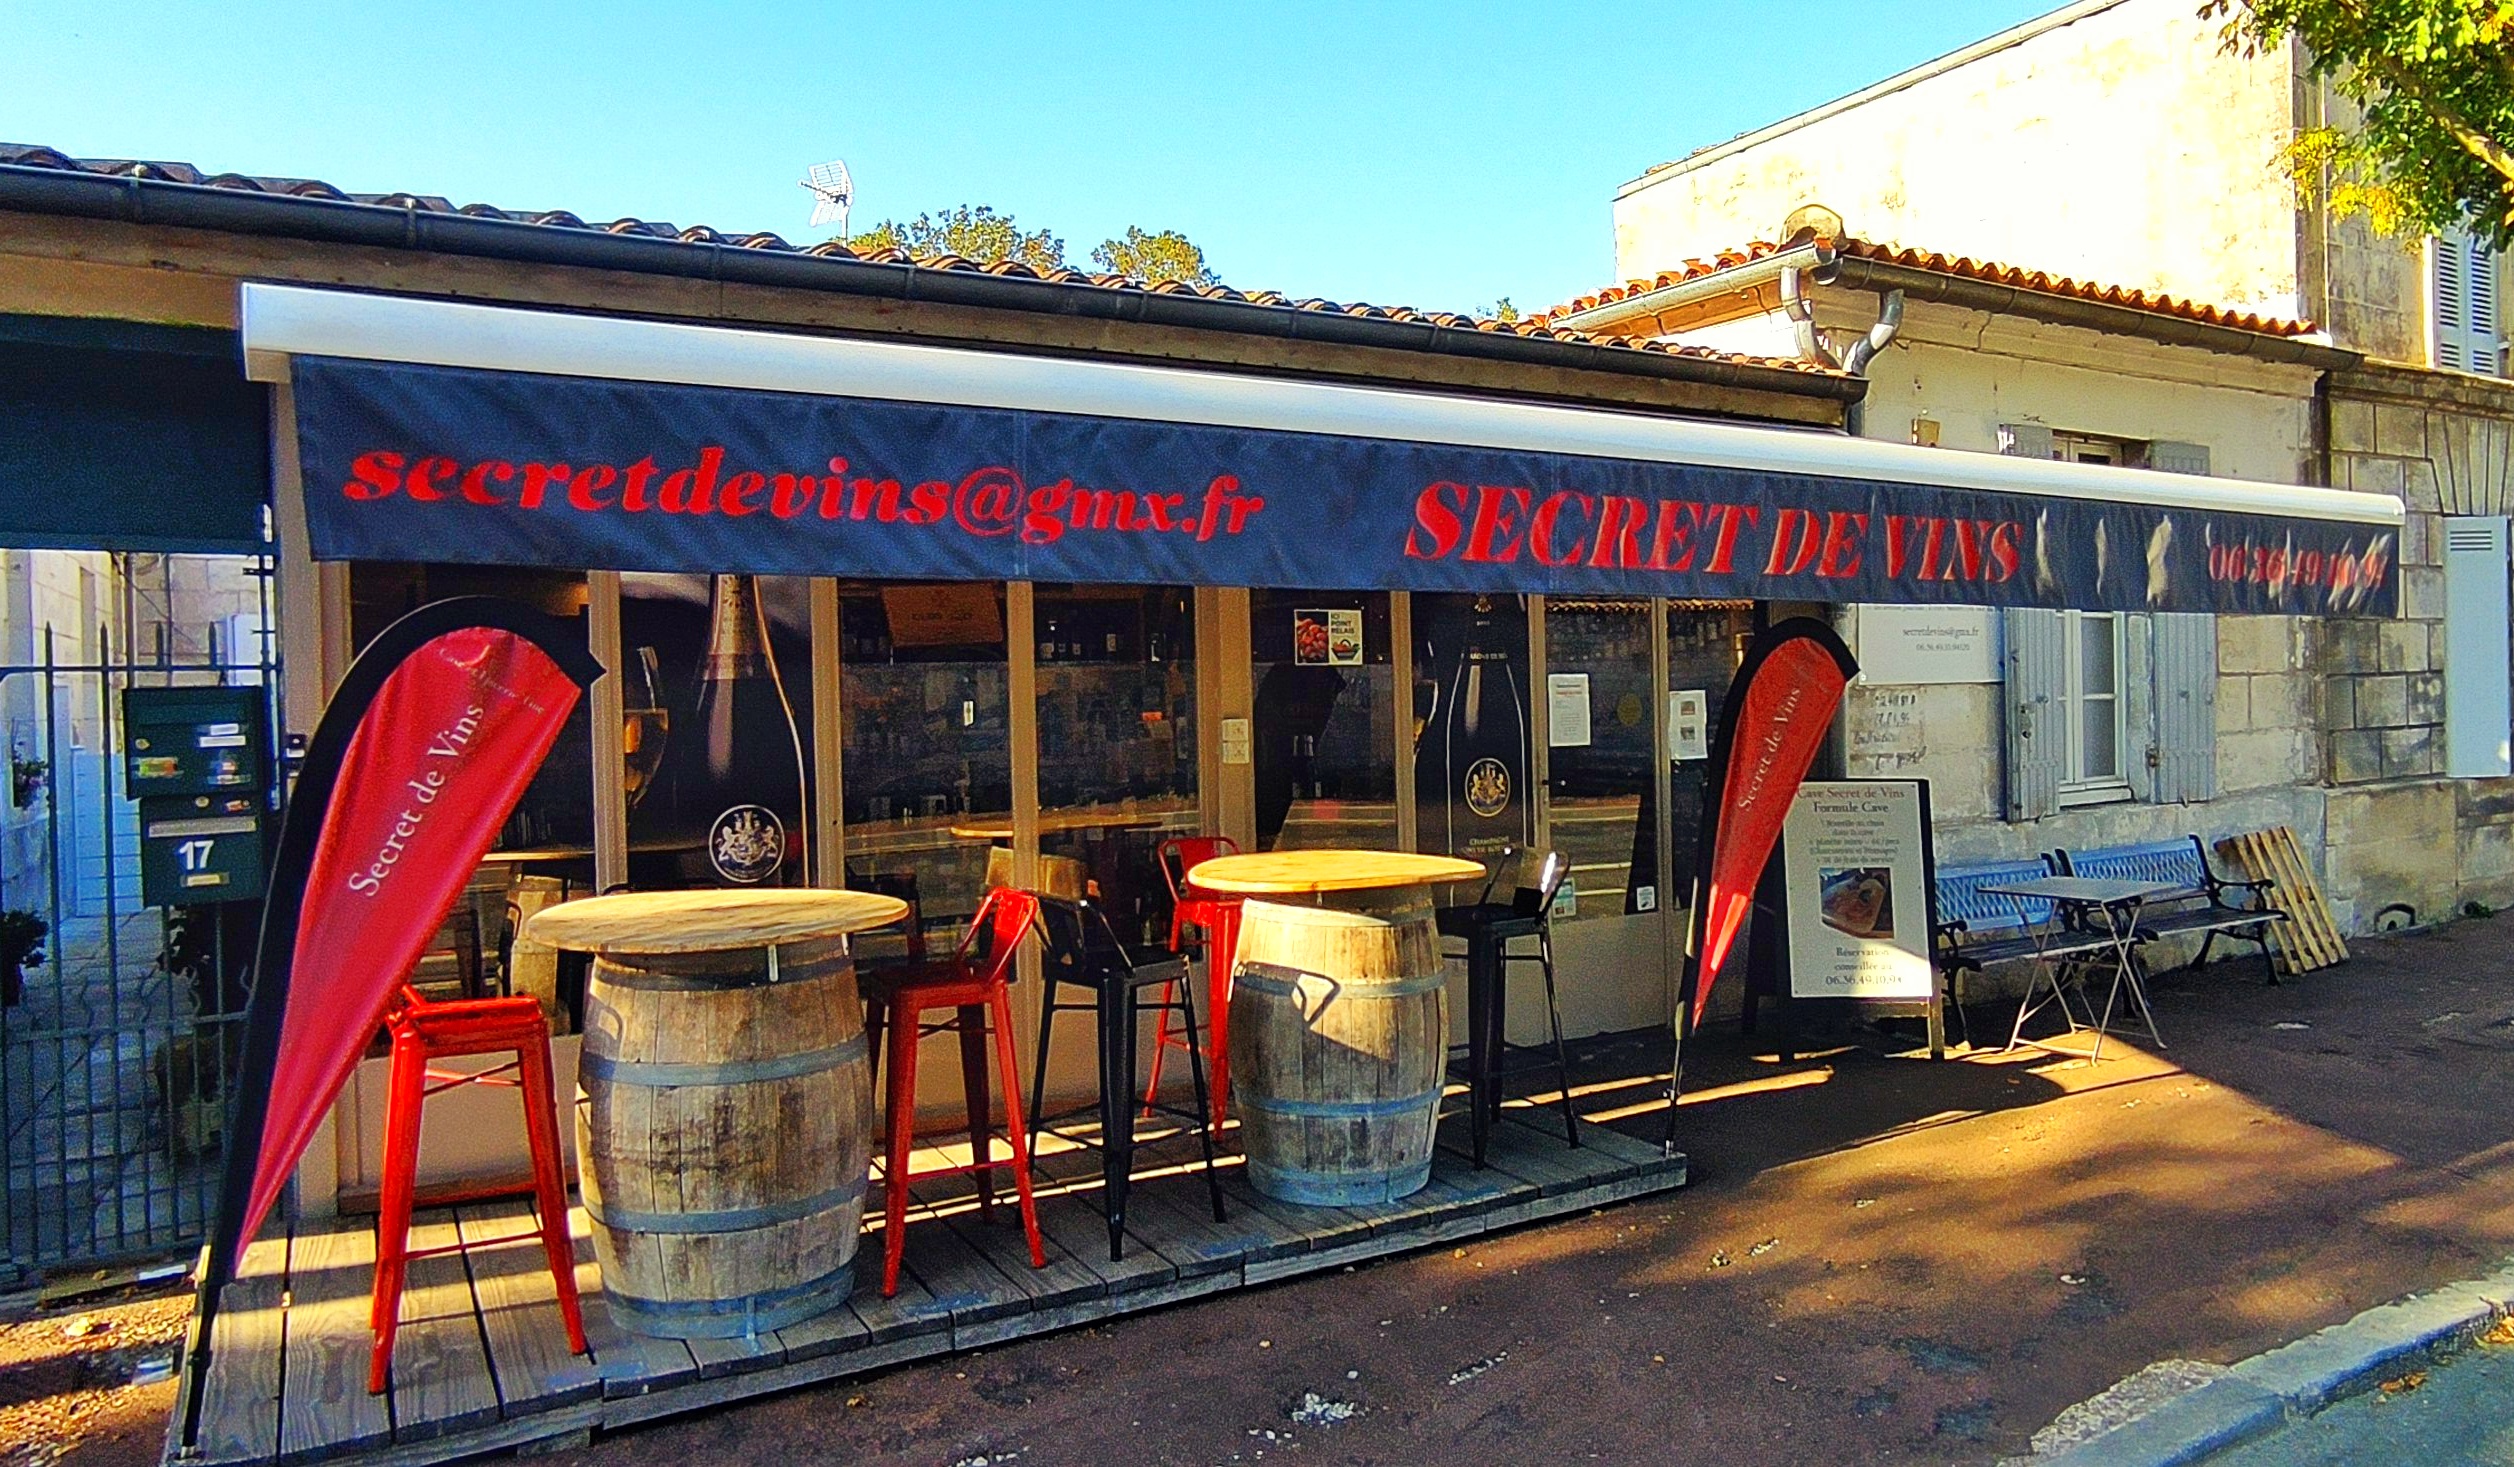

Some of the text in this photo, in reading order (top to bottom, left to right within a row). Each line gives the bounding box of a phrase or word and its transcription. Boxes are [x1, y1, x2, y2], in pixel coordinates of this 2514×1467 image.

[344, 446, 1265, 544] secretdevins@gmx.fr
[1404, 481, 2025, 583] SECRET DE VINS
[1739, 687, 1800, 812] Secret de Vins
[1797, 787, 1905, 799] Cave Secret de Vins
[349, 704, 484, 897] Secret de Vins
[1813, 801, 1889, 813] Formule Cave
[179, 840, 214, 871] 17
